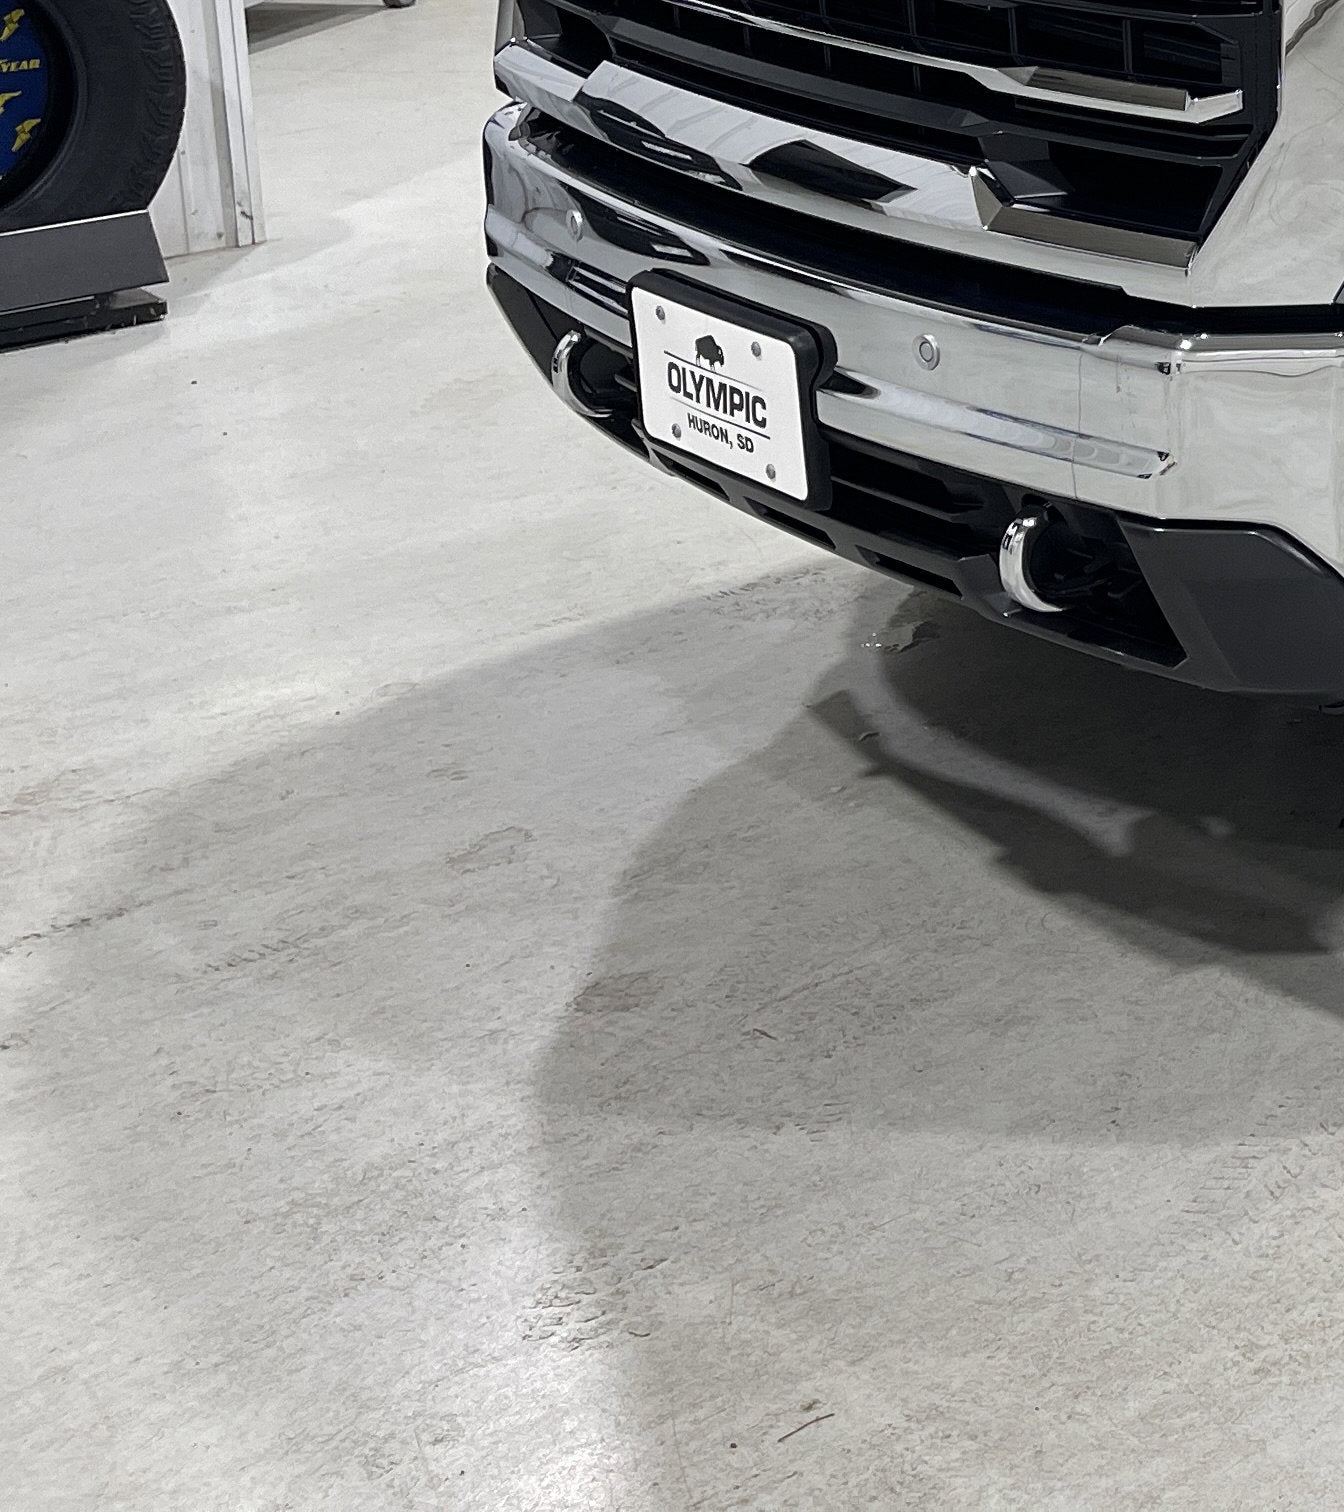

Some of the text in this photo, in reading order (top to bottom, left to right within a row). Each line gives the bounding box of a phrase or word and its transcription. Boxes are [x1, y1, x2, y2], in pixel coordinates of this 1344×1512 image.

[667, 361, 767, 429] OLYMPIC
[687, 412, 755, 454] HURON, SD
